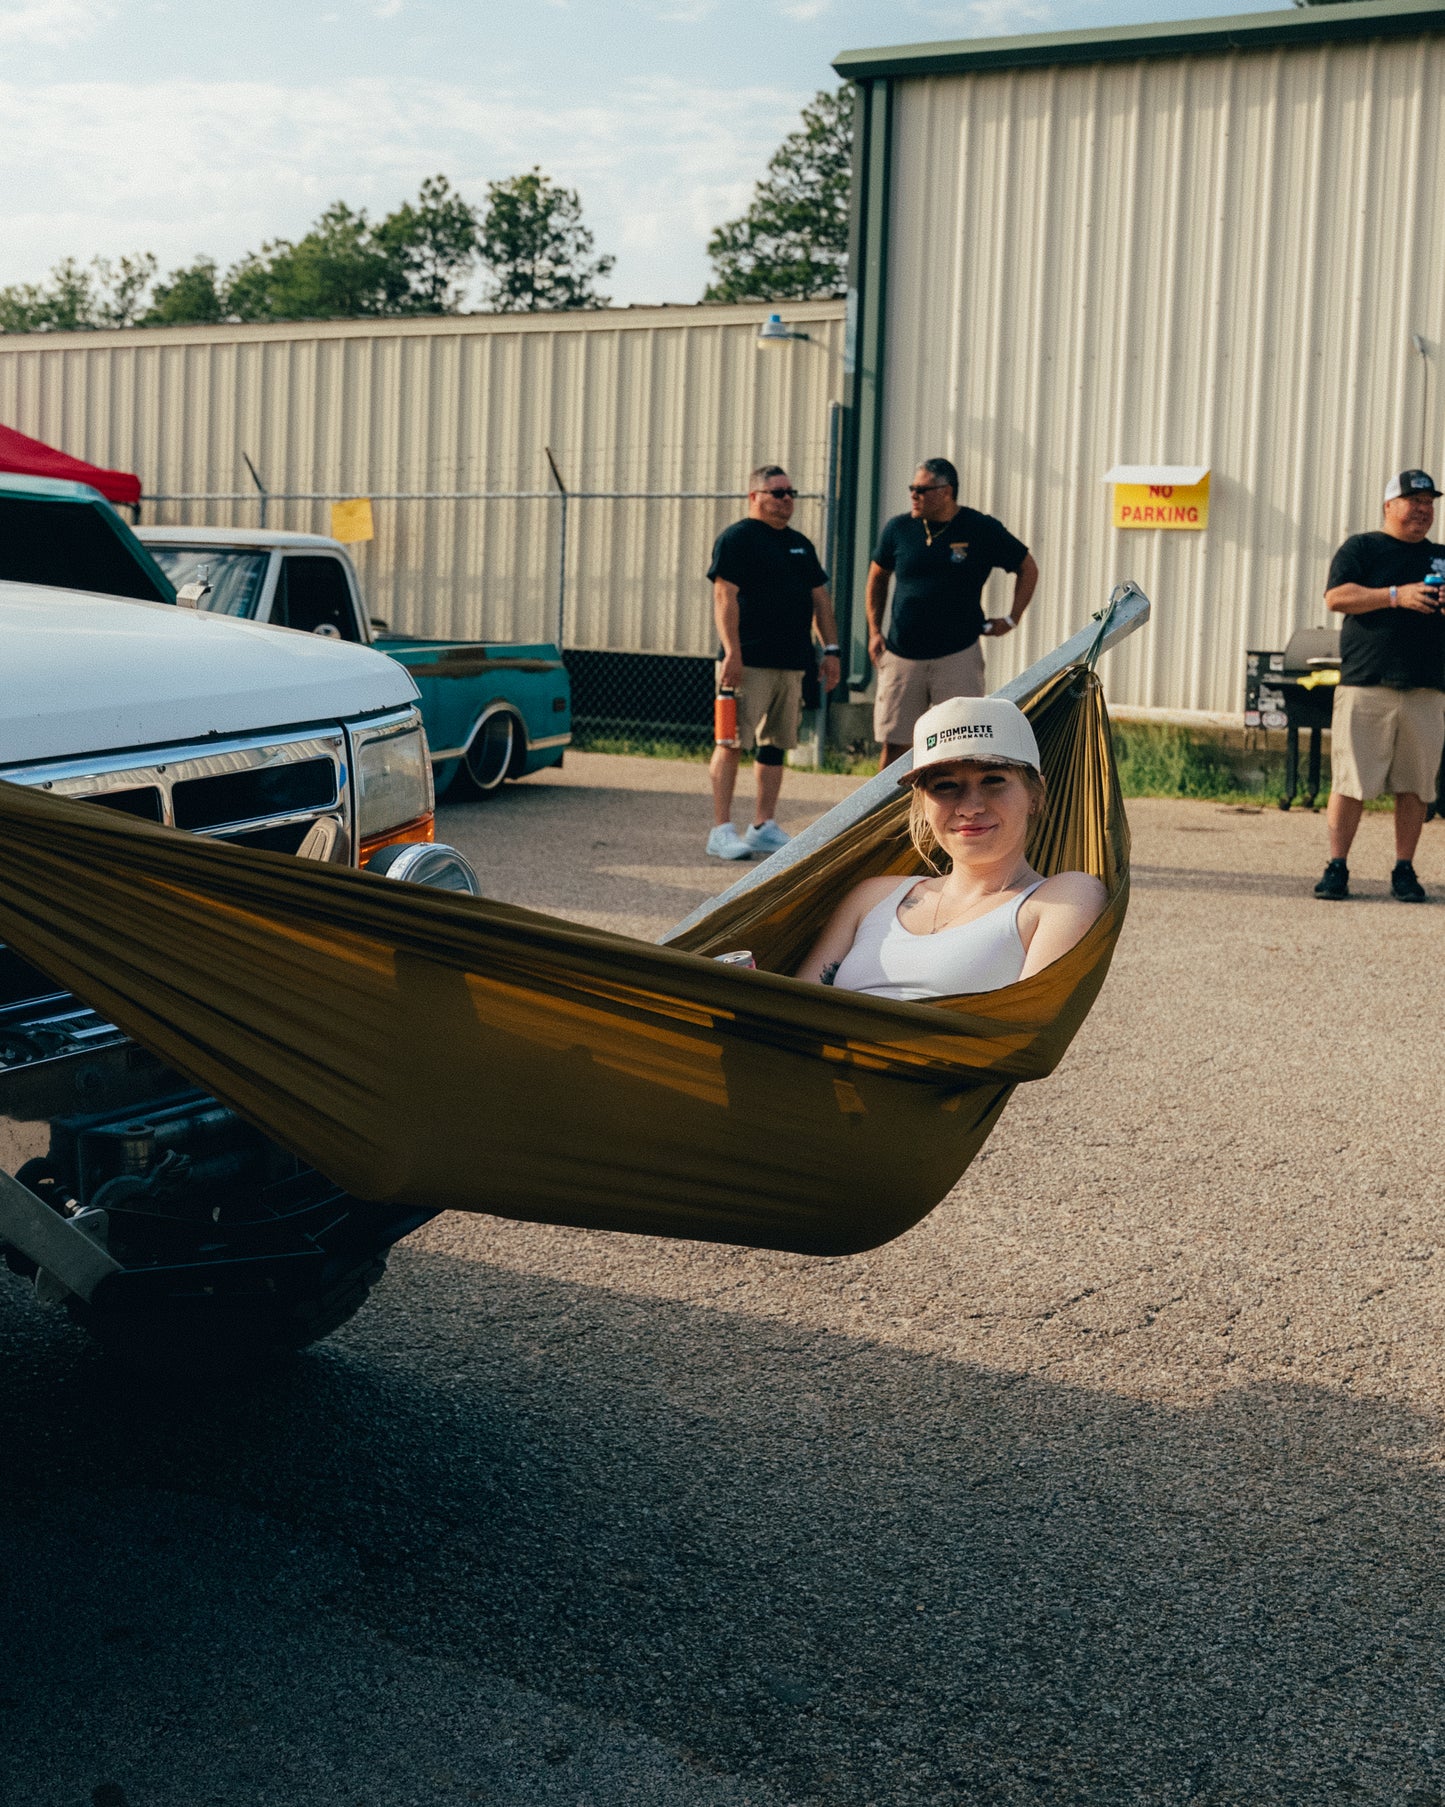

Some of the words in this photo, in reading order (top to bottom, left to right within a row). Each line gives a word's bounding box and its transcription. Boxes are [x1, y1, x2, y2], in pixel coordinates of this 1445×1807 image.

[1150, 485, 1174, 498] NO
[1121, 506, 1198, 522] PARKING
[940, 725, 993, 739] COMPLETE
[940, 733, 994, 744] PERFORMANCE
